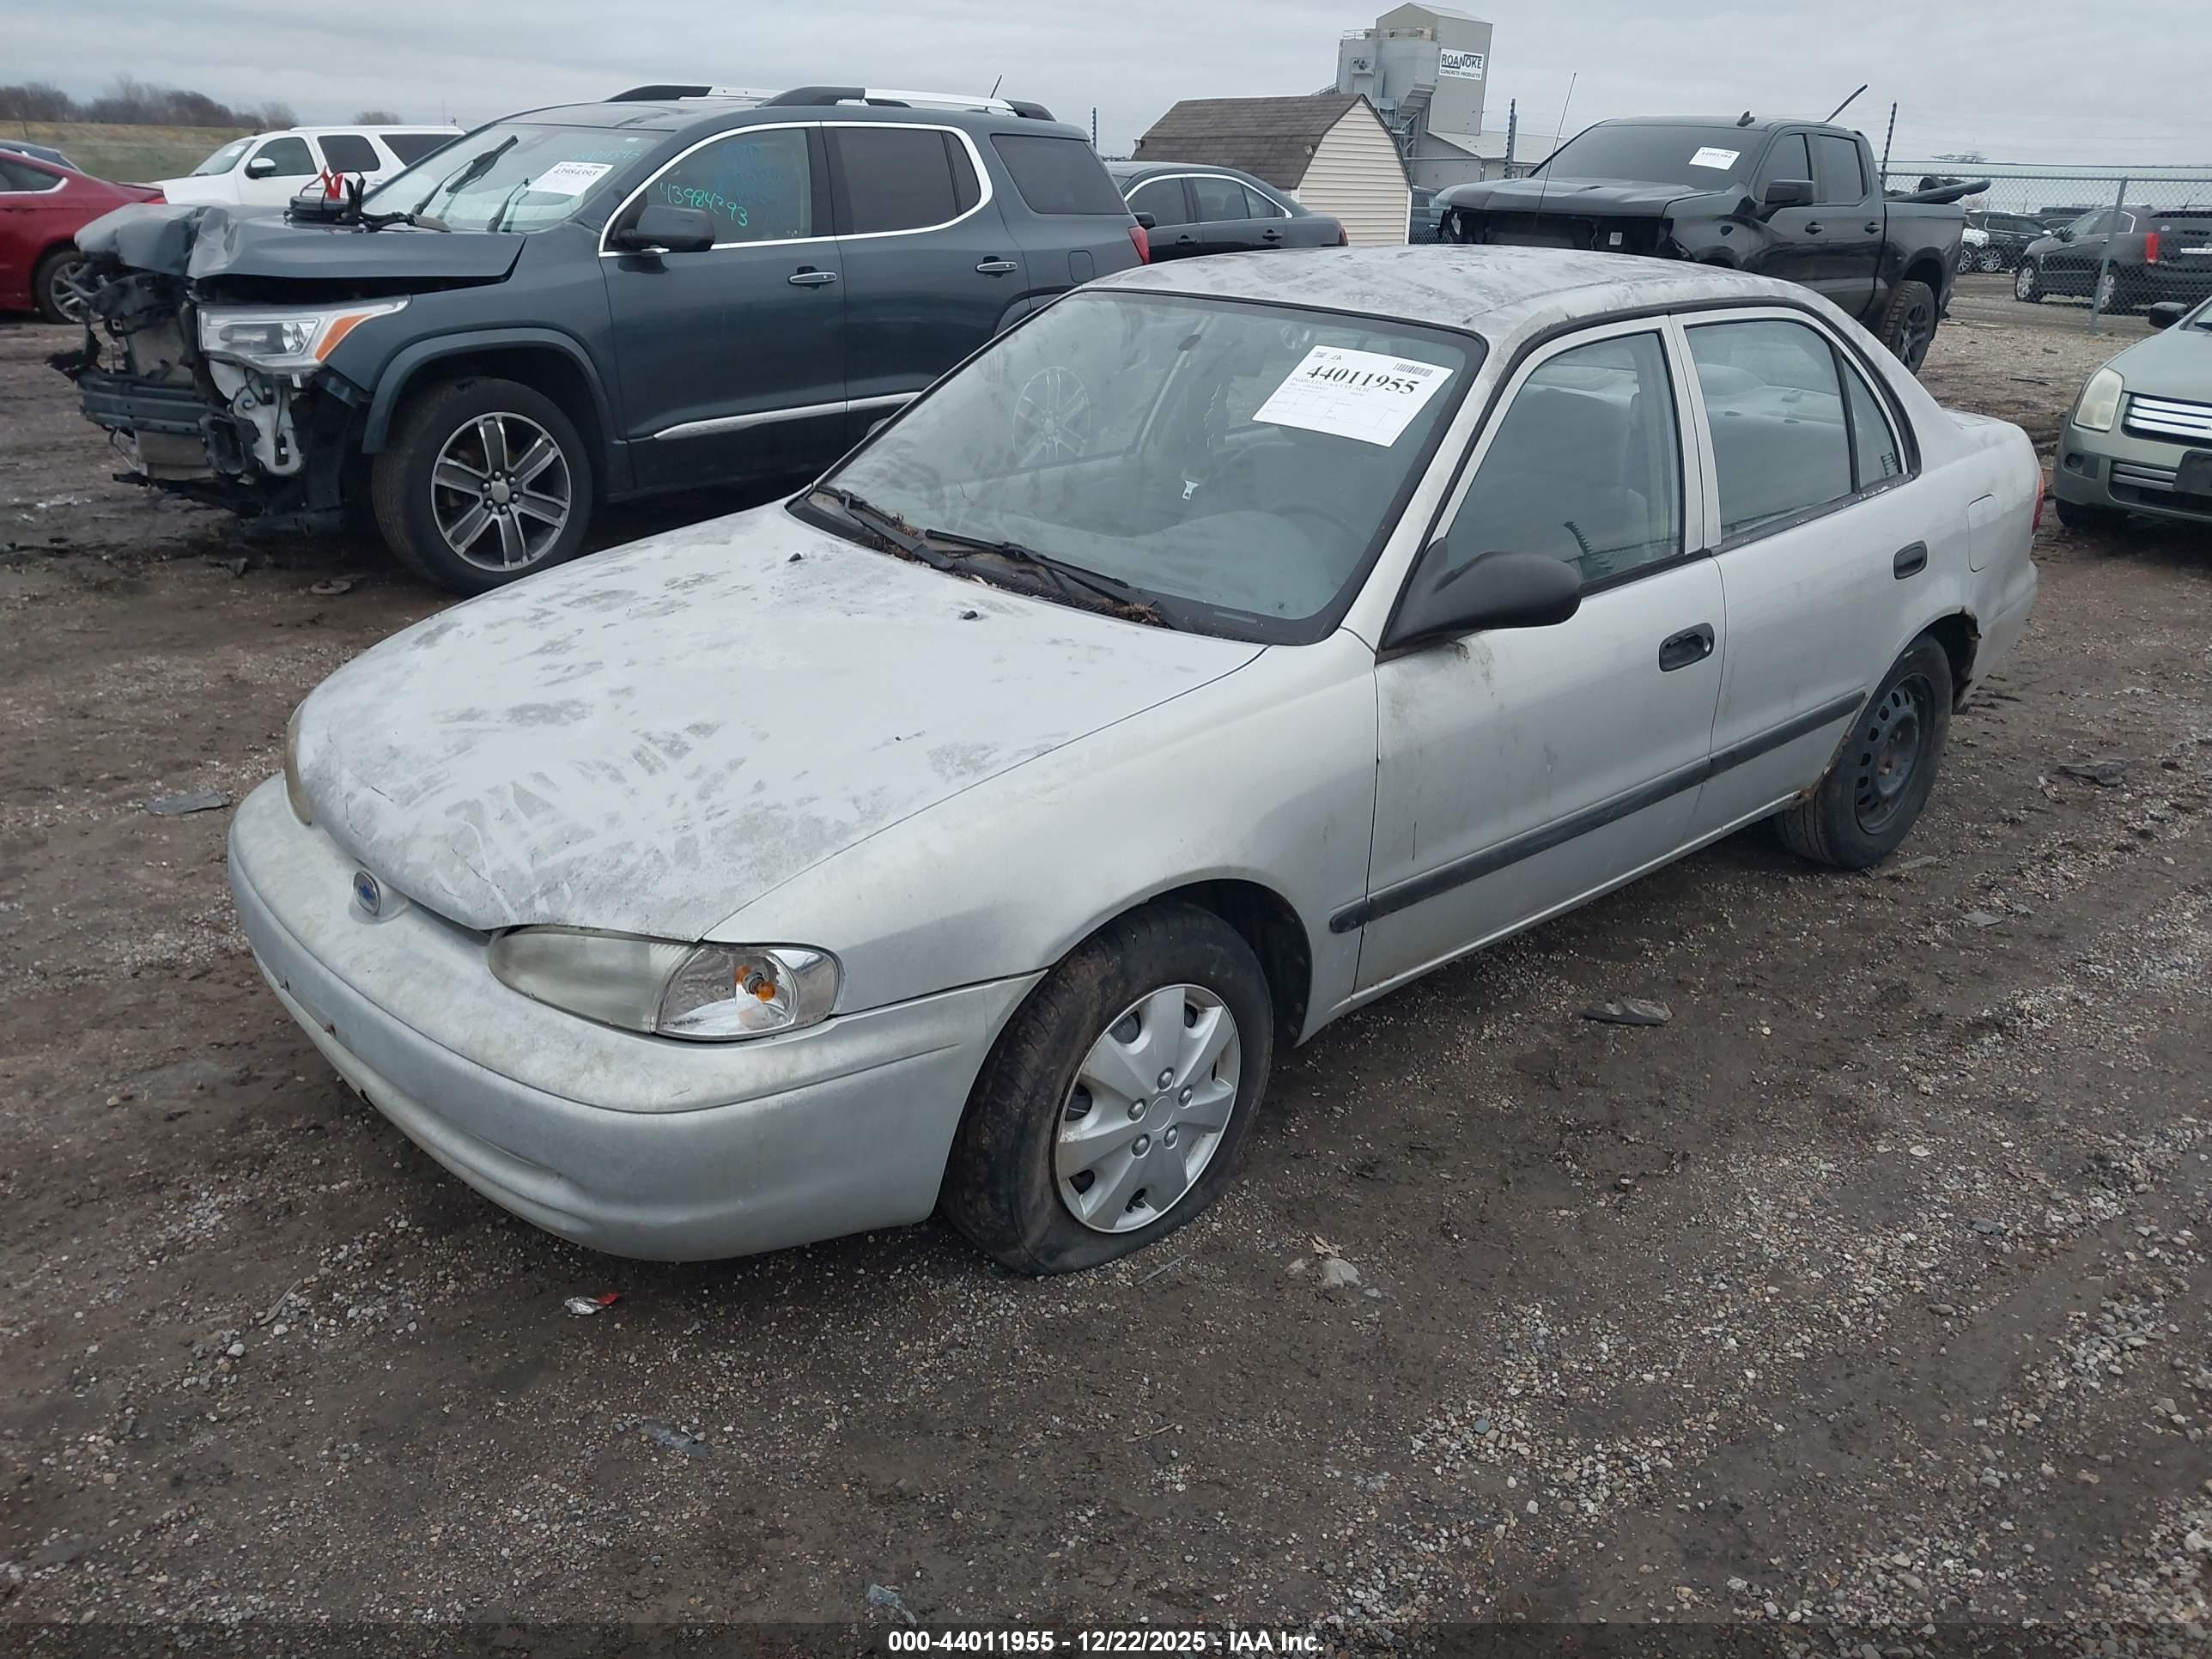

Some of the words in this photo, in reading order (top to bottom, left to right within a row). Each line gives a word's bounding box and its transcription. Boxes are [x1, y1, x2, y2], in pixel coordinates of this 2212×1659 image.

[1442, 54, 1482, 69] ROANOKE
[659, 181, 748, 227] 43984293
[1307, 365, 1420, 395] 44011955
